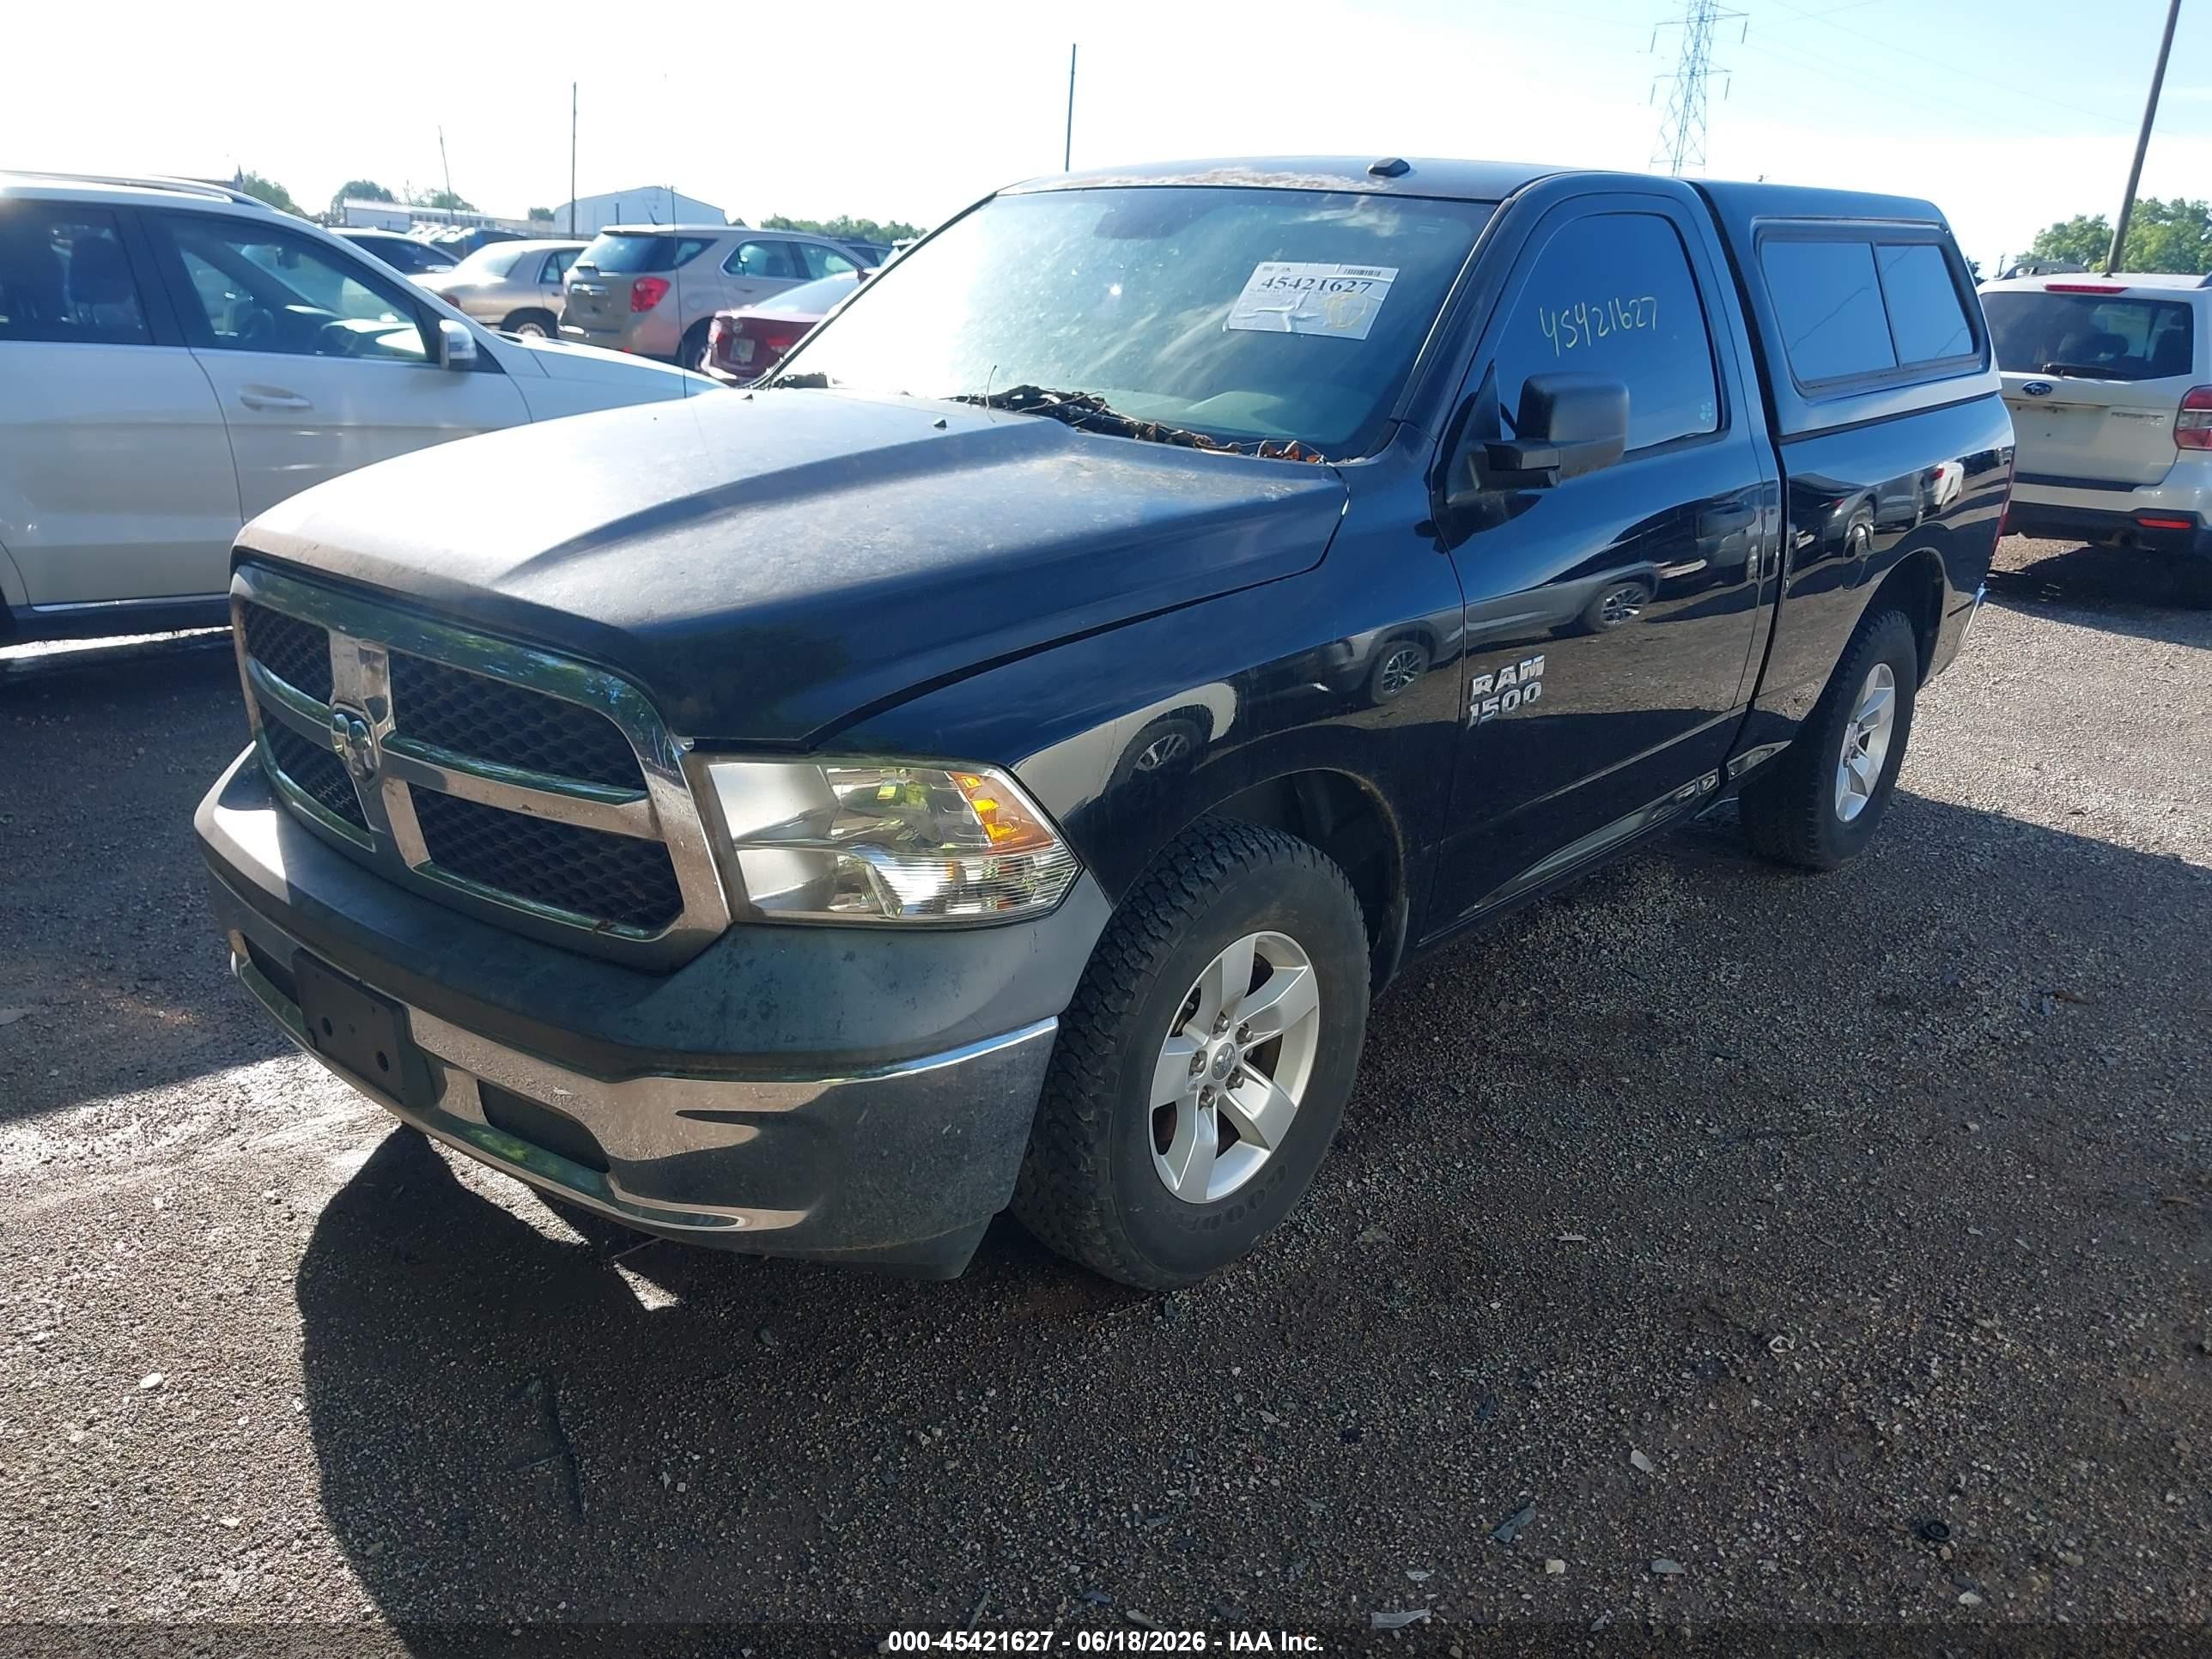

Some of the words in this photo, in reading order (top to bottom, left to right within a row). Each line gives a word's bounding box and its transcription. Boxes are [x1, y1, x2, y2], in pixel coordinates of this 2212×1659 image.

[1261, 275, 1373, 295] 45421627
[1539, 295, 1658, 358] 45421627
[1470, 654, 1546, 700] RAM
[1466, 681, 1543, 730] 1500
